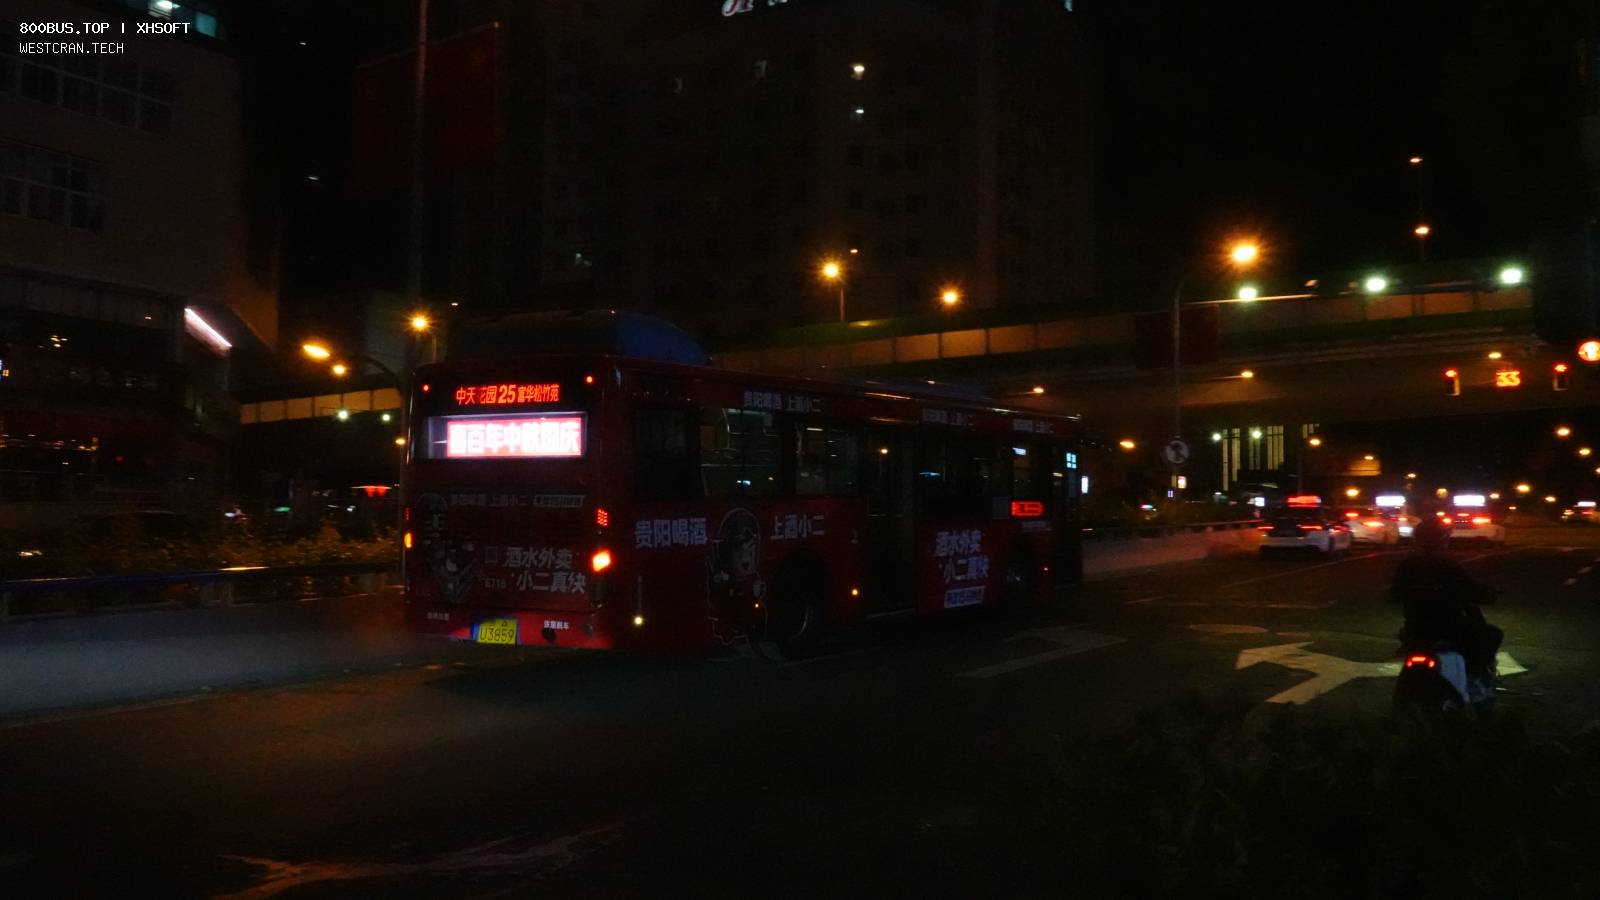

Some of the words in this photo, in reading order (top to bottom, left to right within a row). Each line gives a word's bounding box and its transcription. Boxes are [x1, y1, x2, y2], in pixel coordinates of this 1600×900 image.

[1496, 371, 1520, 387] 33
[498, 384, 516, 404] 25
[634, 517, 709, 549] 贵阳喝酒
[771, 513, 826, 540] 上酒小二
[504, 546, 573, 569] 酒水外卖
[516, 571, 586, 593] 小二真快
[480, 626, 515, 642] U3859
